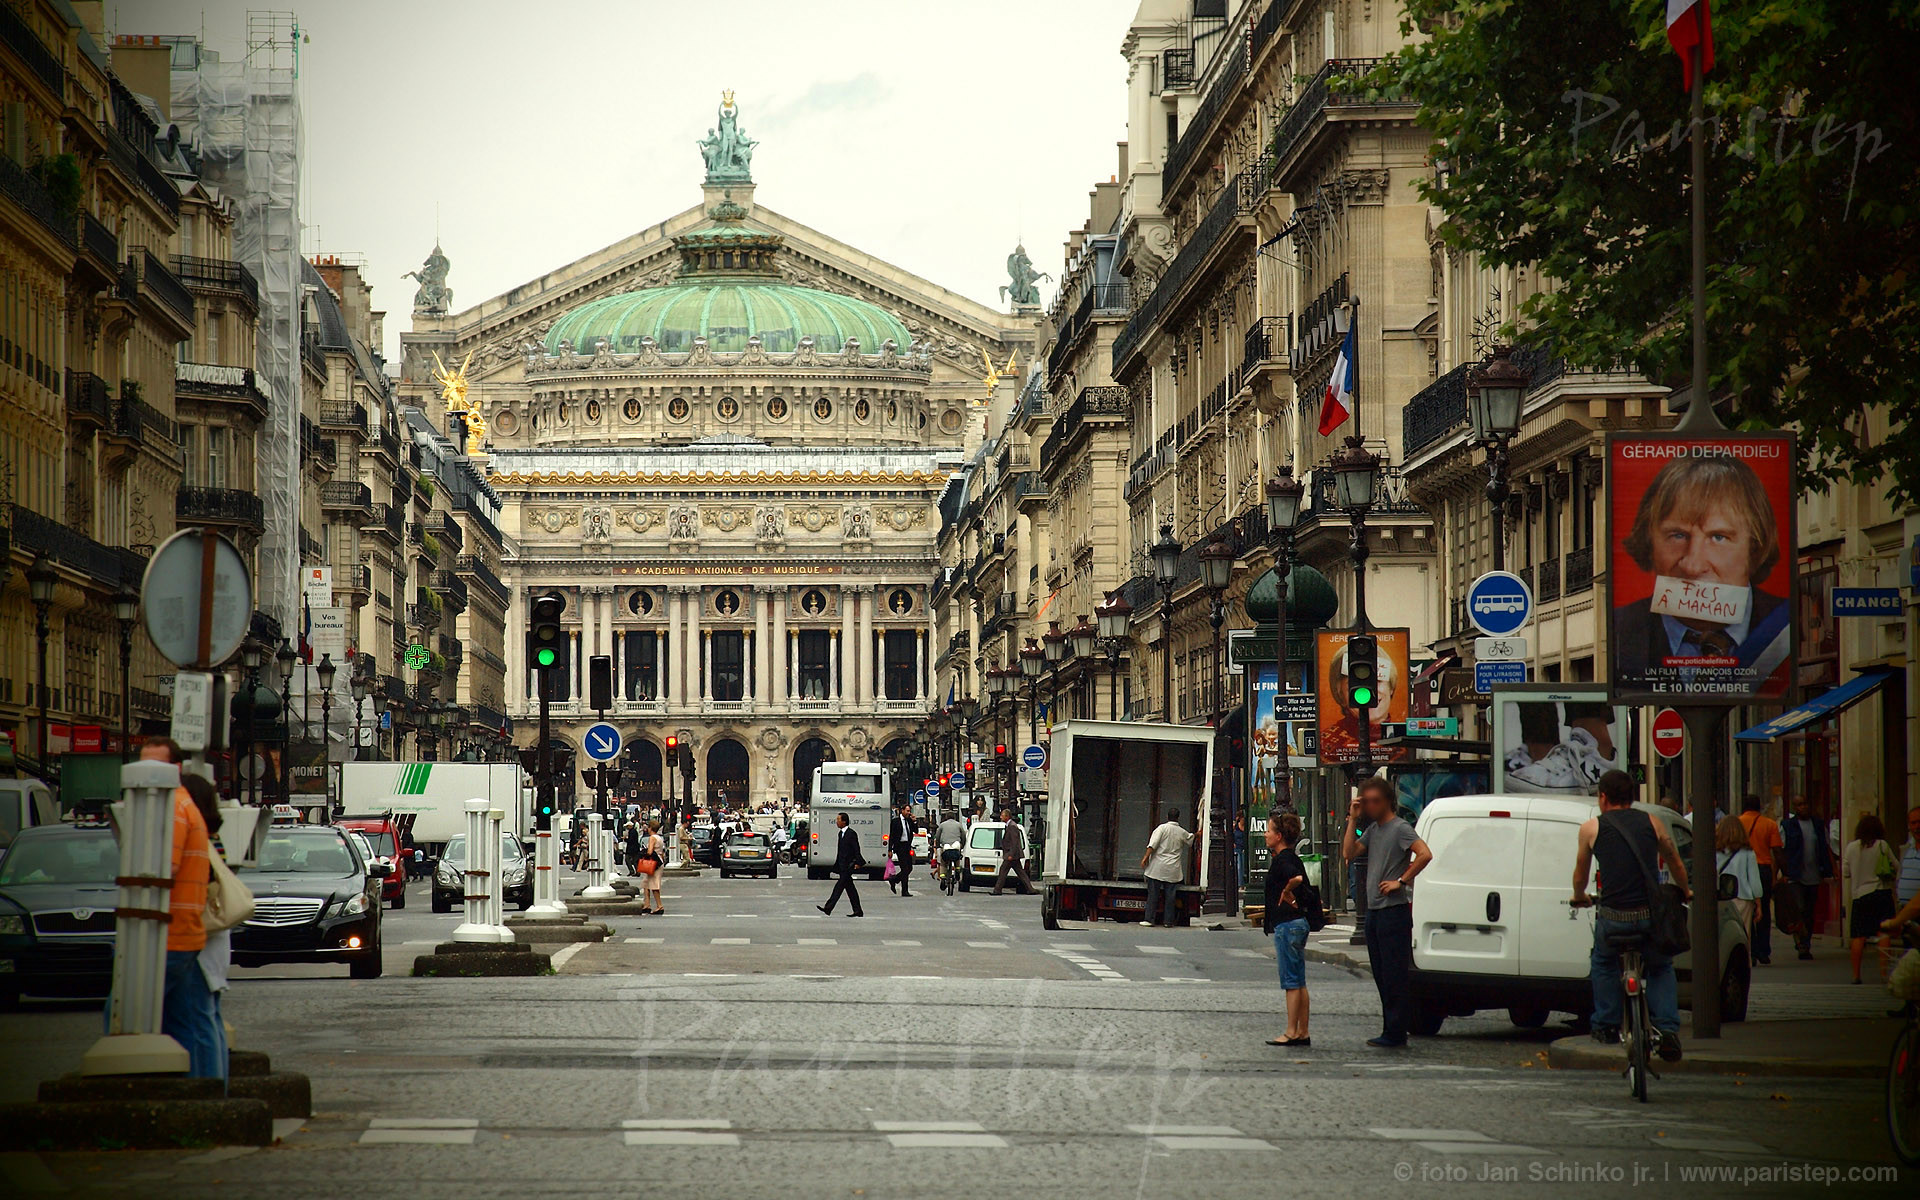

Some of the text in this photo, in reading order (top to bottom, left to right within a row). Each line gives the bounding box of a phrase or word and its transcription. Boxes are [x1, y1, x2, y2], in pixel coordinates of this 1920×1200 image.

[1622, 443, 1780, 458] GÉRARD DEPARDIEU
[635, 567, 686, 575] ACADEMIE
[774, 566, 820, 574] MUSIQUE
[1835, 597, 1900, 608] CHANGE
[1678, 599, 1737, 618] MAMAN
[1666, 657, 1736, 666] www.potichelefilm.fr
[1644, 668, 1657, 676] UN
[1659, 668, 1677, 676] FILM
[1679, 668, 1690, 676] DE
[1691, 667, 1732, 677] FRANÇOIS
[1253, 682, 1300, 691] LE FINL...
[1652, 683, 1750, 693] LE 10 NOVEMBRE
[294, 766, 324, 777] MONET
